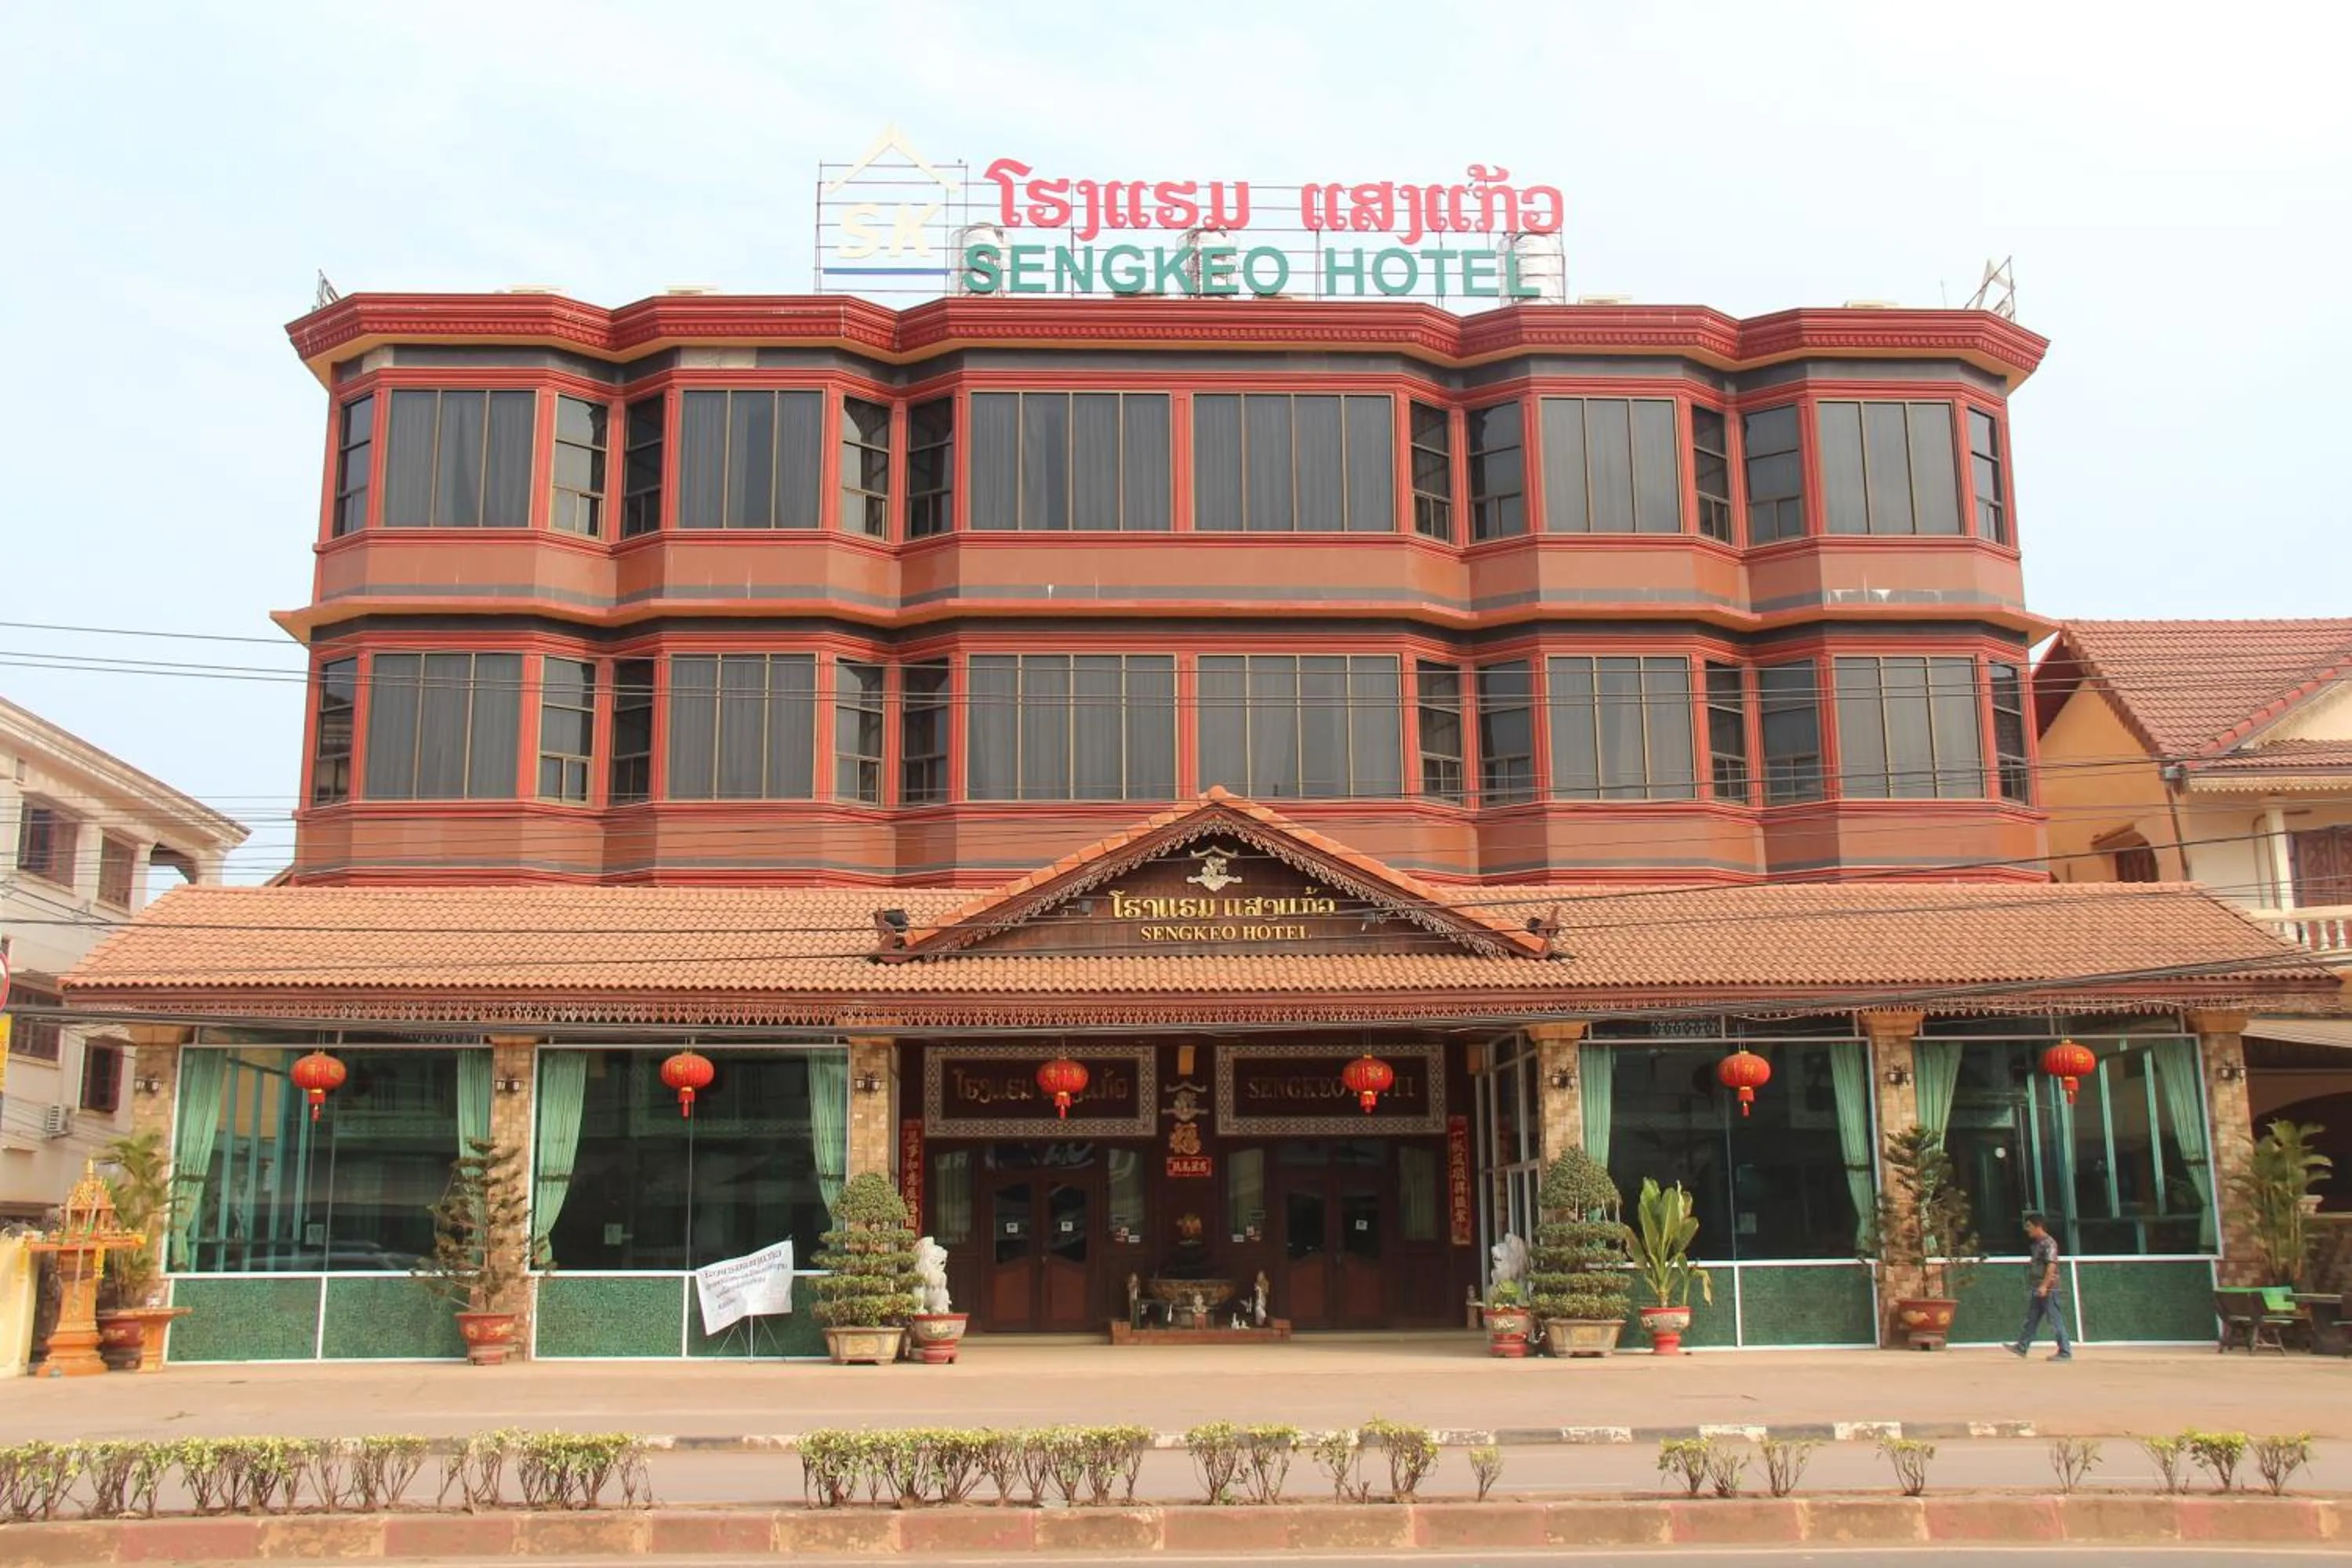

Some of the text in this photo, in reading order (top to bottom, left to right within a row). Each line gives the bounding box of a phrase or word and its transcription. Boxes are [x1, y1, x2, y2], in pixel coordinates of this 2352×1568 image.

[984, 158, 1563, 245] ໂຮງແຮມ ແສງແກ້ວ
[837, 203, 941, 259] SK
[963, 244, 1541, 297] SENGKEO HOTEL
[1141, 925, 1311, 940] SENGKEO HOTEL
